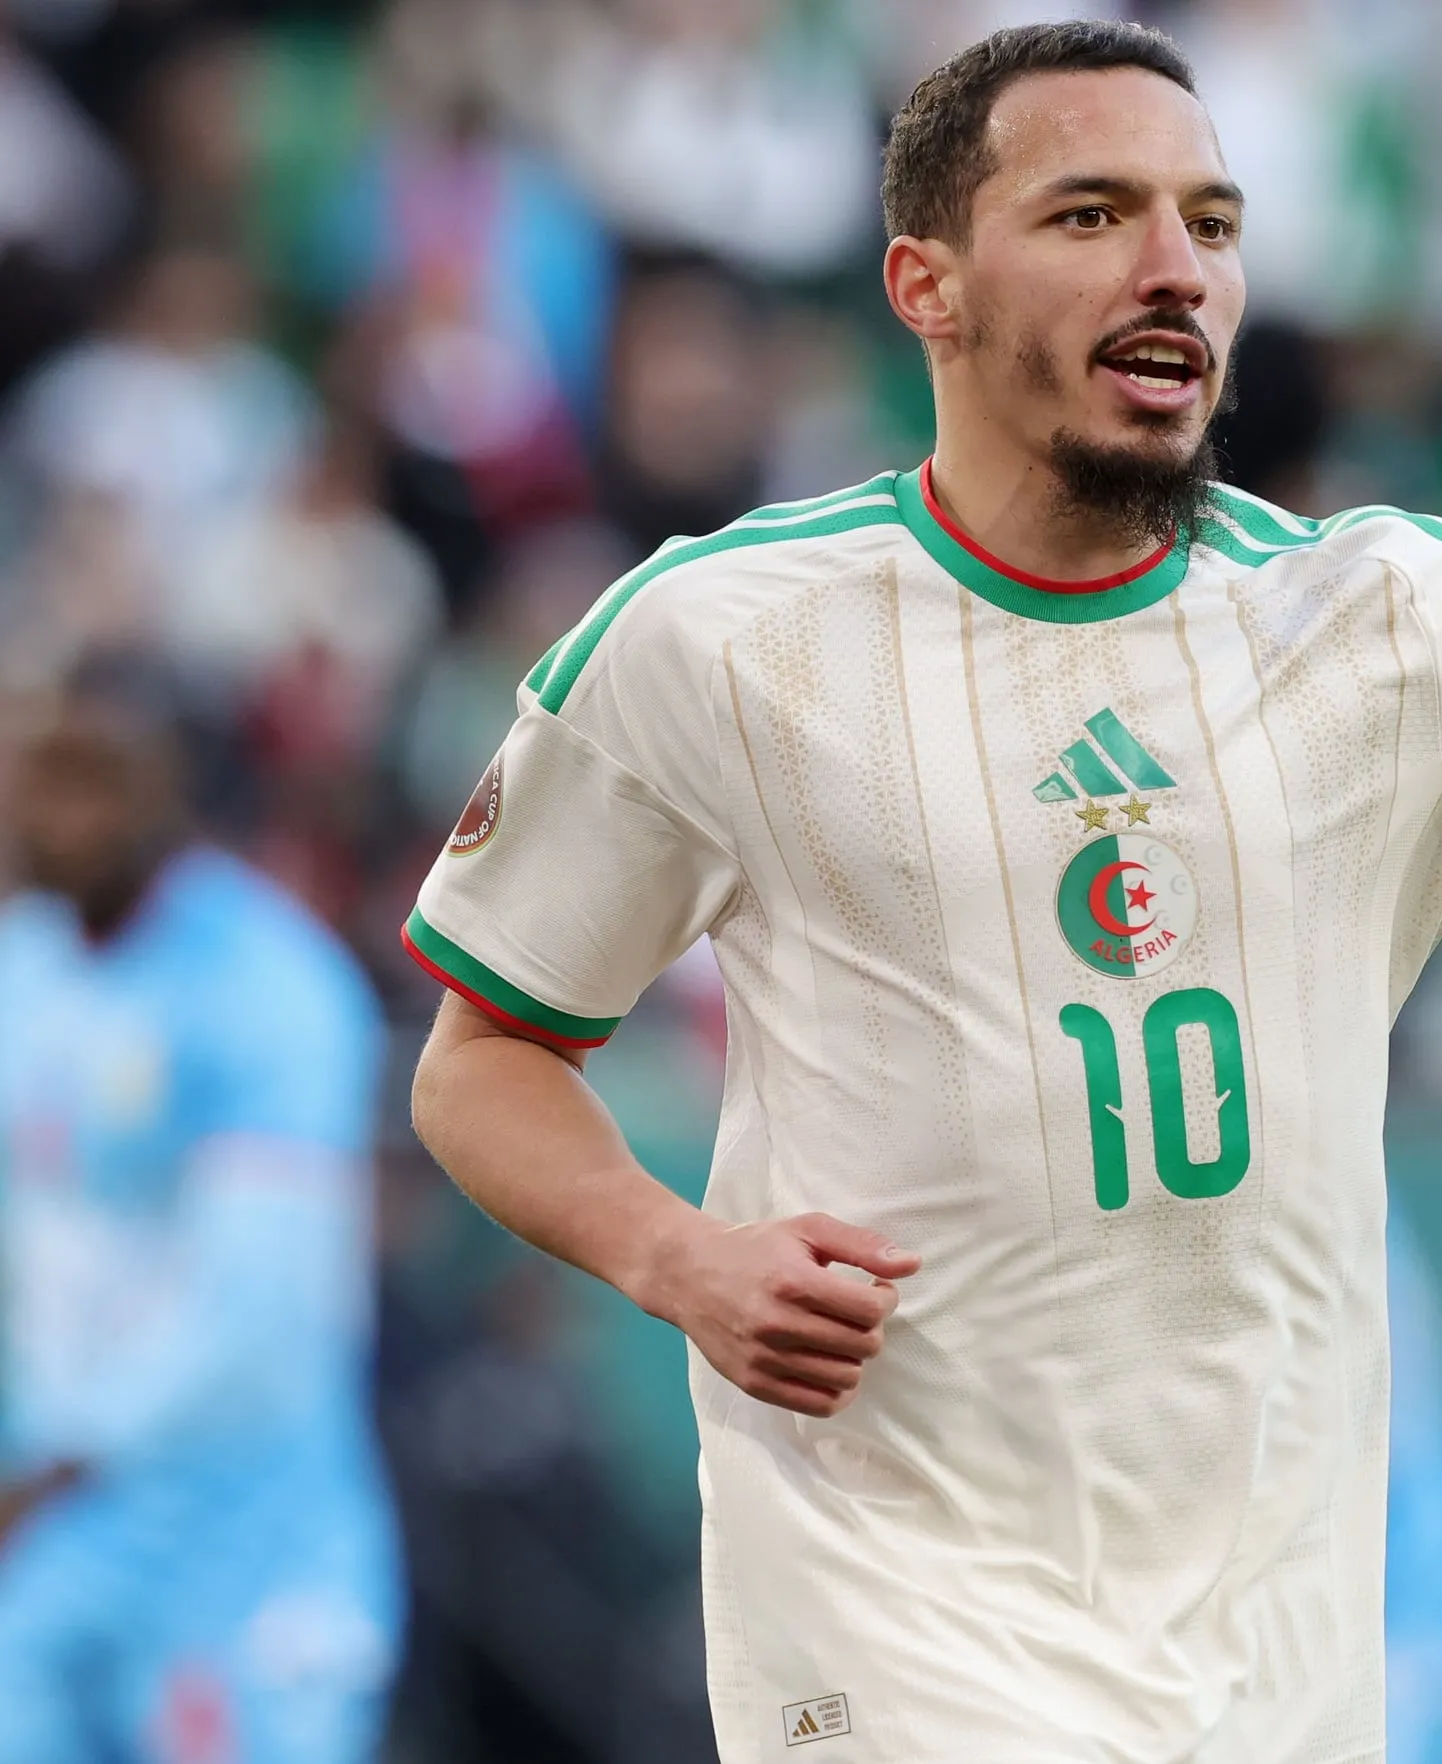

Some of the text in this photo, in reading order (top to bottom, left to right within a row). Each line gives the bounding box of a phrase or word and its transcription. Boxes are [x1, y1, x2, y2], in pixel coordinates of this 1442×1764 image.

[488, 794, 498, 821] CUP
[479, 821, 490, 839] OF
[1089, 929, 1177, 964] ALGERIA
[1059, 987, 1251, 1211] 10
